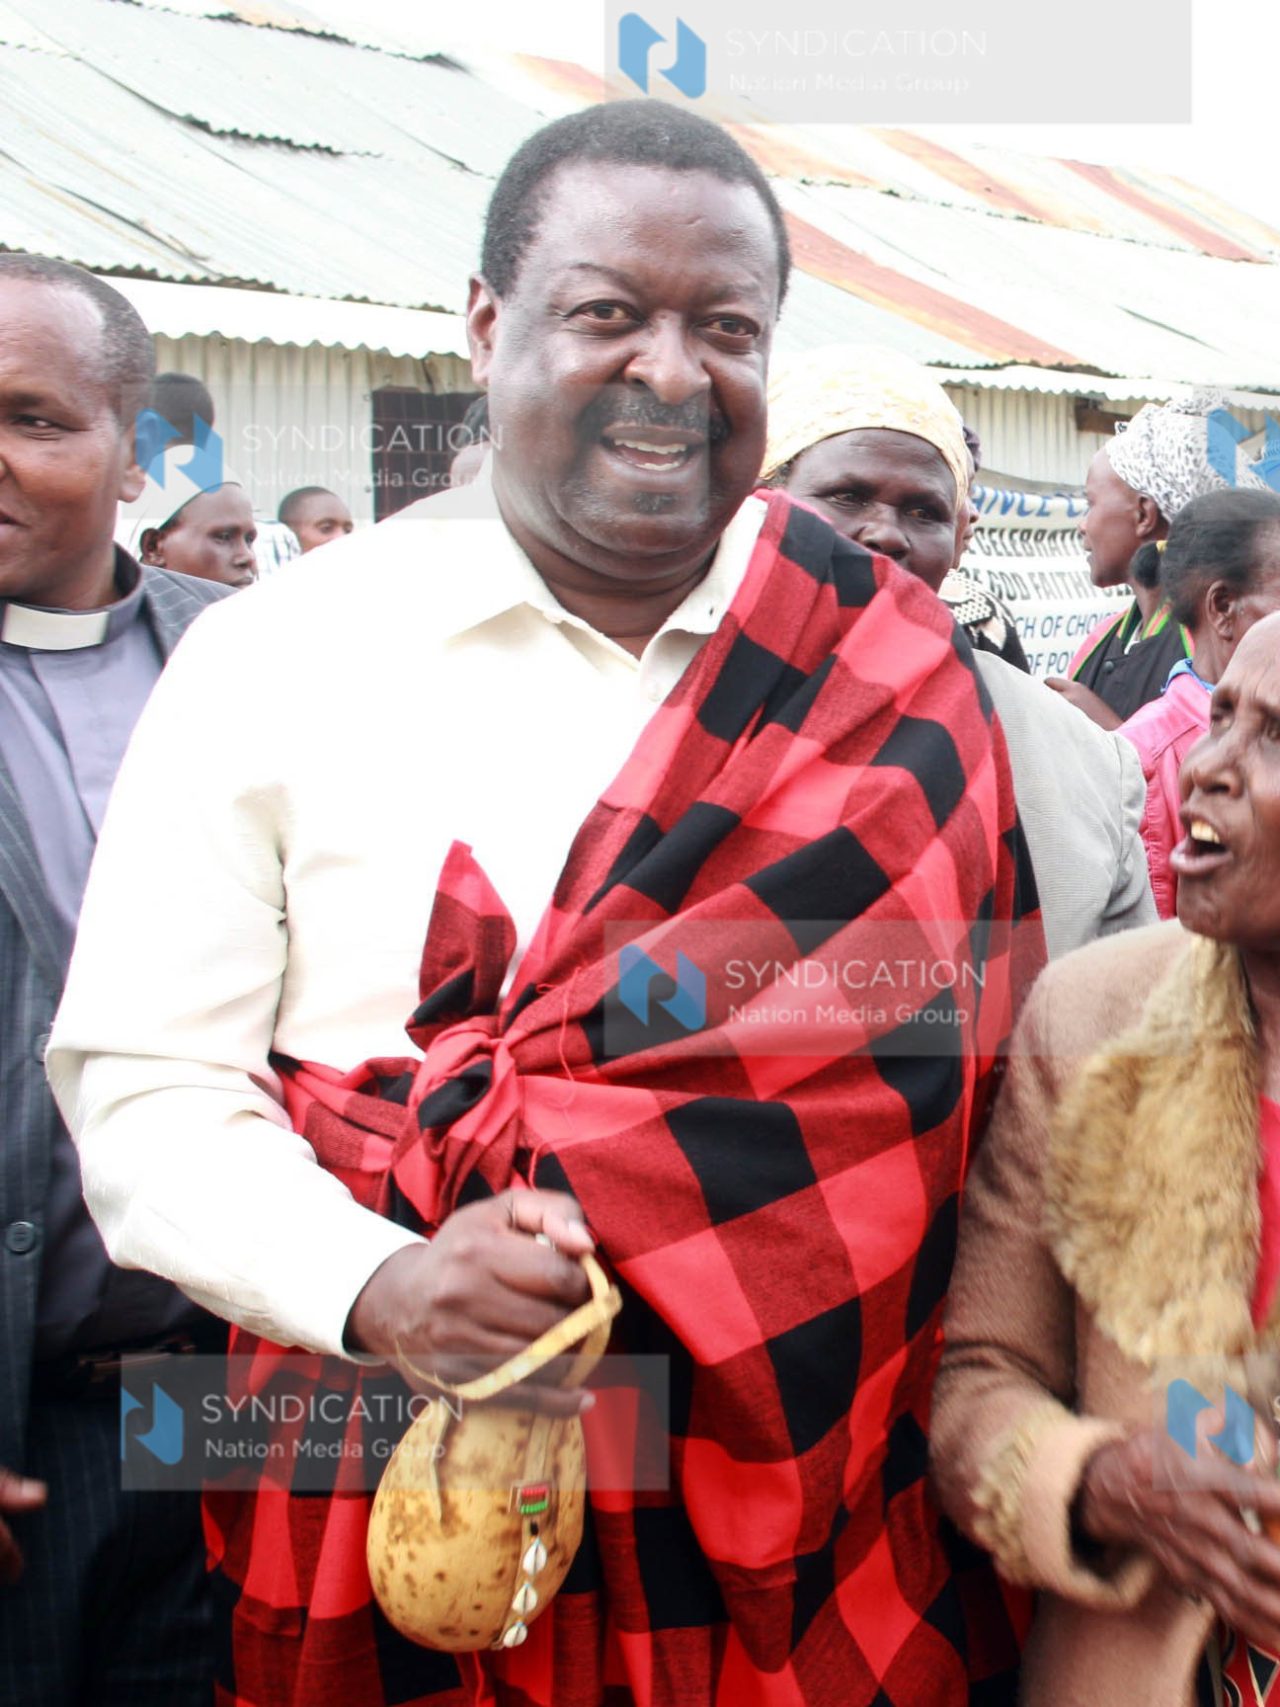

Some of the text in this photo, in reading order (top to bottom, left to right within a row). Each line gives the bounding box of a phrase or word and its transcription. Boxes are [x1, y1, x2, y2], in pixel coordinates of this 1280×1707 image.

[973, 526, 1083, 557] CELEBRATI
[986, 569, 1030, 601] GOD
[1040, 615, 1063, 638] OF
[1046, 650, 1075, 675] PO
